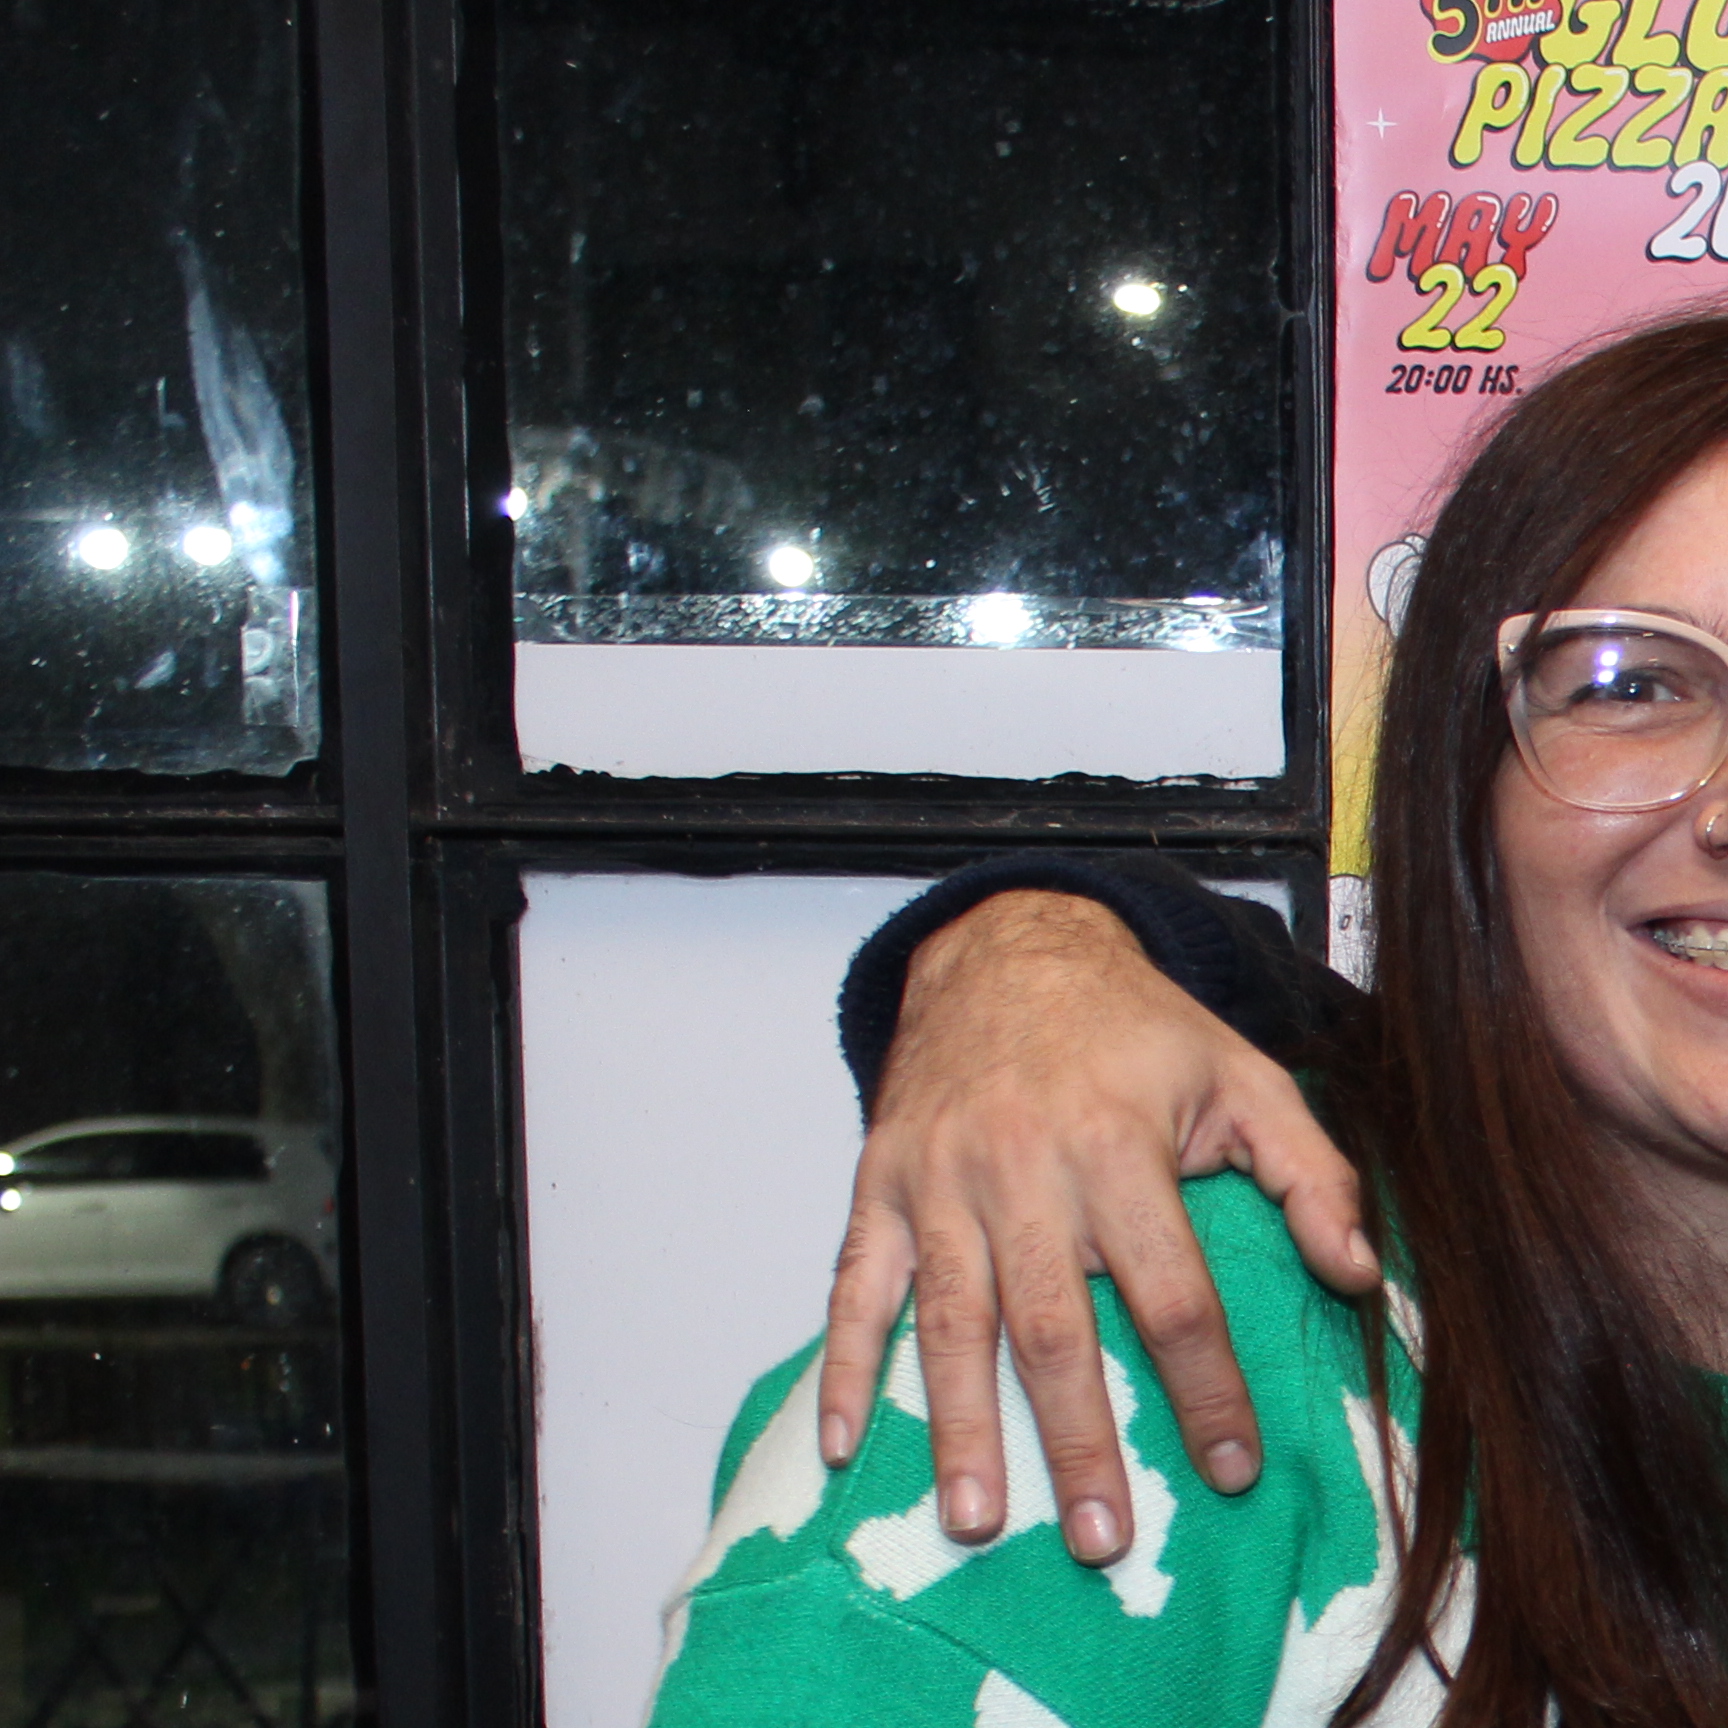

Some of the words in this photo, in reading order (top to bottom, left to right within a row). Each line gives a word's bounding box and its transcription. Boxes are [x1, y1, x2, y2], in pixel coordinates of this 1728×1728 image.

[1485, 10, 1556, 43] ANNUAL
[1366, 190, 1559, 285] MAY
[1397, 261, 1519, 353] 22
[1385, 364, 1472, 394] 20:00
[1478, 364, 1523, 394] HS.
